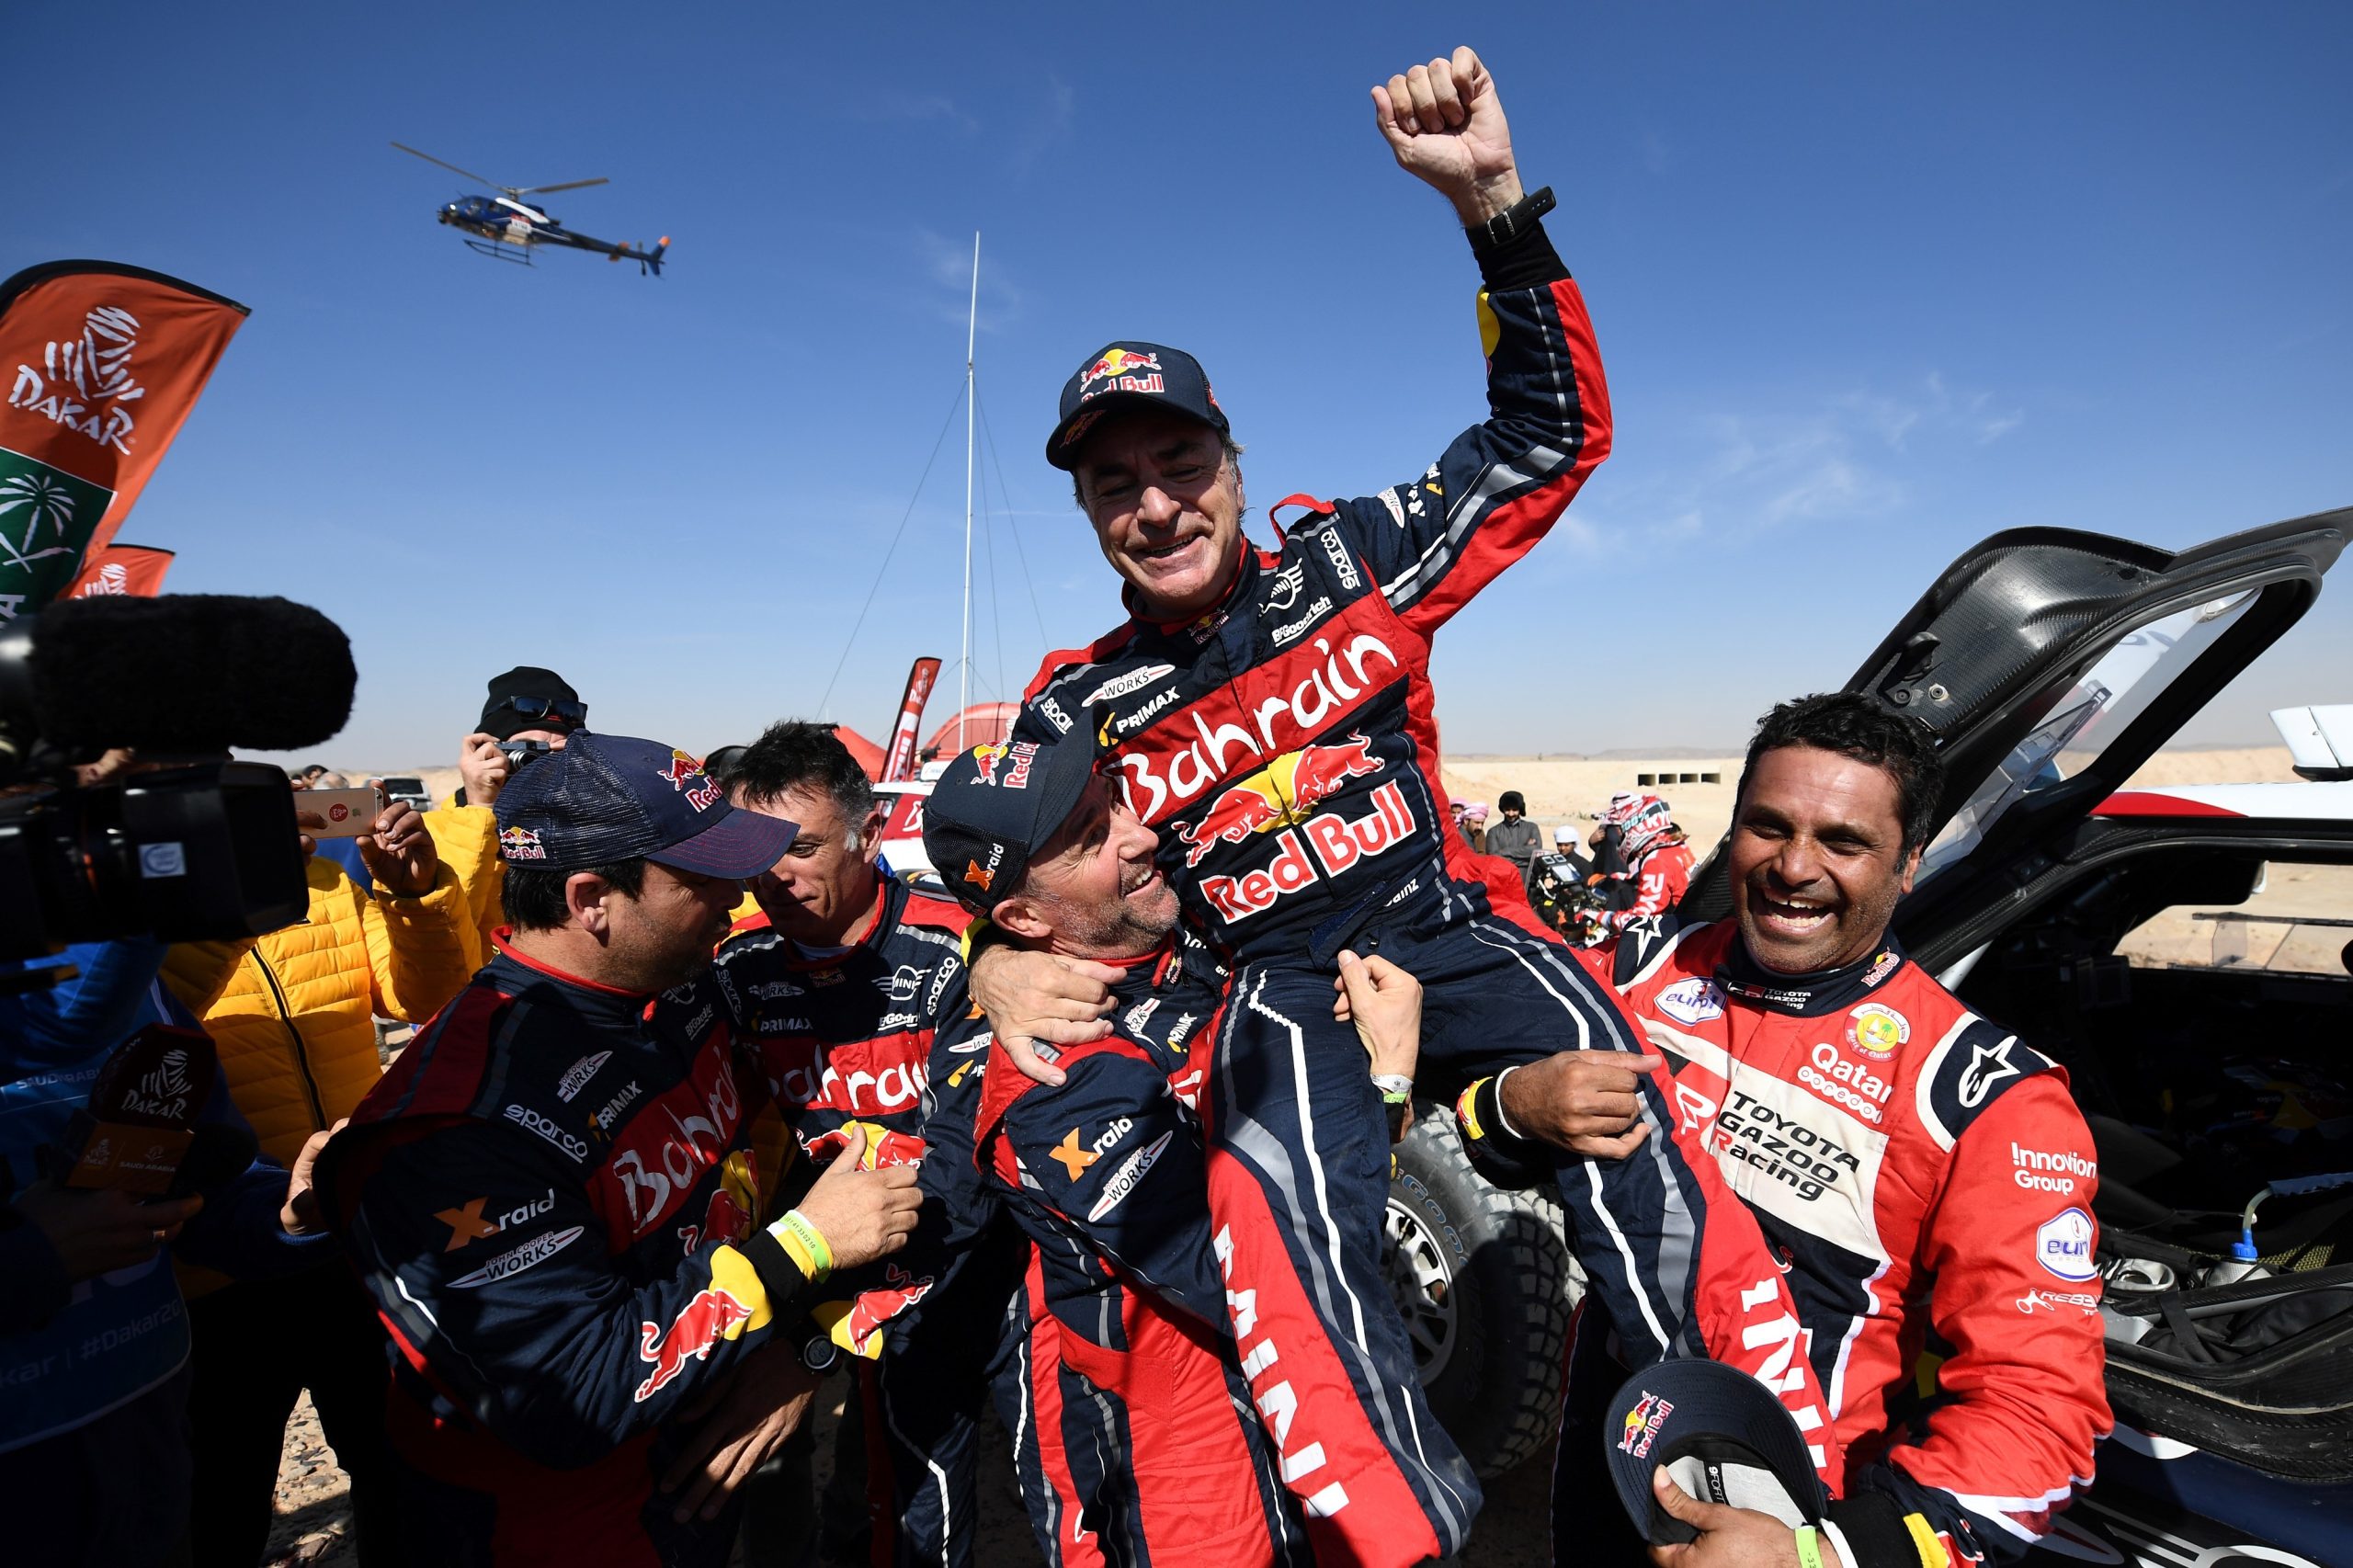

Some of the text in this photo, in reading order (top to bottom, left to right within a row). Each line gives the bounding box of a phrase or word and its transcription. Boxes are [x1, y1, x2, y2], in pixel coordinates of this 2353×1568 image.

[7, 364, 135, 456] DAKAR
[1320, 528, 1360, 590] sparco
[1104, 671, 1150, 698] WORKS
[1040, 698, 1074, 735] spar
[1104, 634, 1399, 825] Bahrain
[1116, 686, 1180, 733] PRIMAX
[685, 775, 723, 813] Red
[1003, 752, 1034, 790] Red
[1199, 778, 1416, 925] Red Bull
[759, 1017, 813, 1032] PRIMAX
[119, 1089, 188, 1120] DAKAR
[597, 1081, 642, 1130] PRIMAX
[504, 1104, 588, 1160] sparco
[1718, 1110, 1839, 1183] GAZOO
[1733, 1090, 1861, 1174] TOYOTA
[1108, 1152, 1153, 1201] WORKS
[1711, 1129, 1825, 1202] Racing
[2014, 1169, 2075, 1197] Group
[486, 1231, 554, 1268] JOHN COOPER
[486, 1238, 557, 1279] WORKS
[1632, 1398, 1675, 1460] Red Bull
